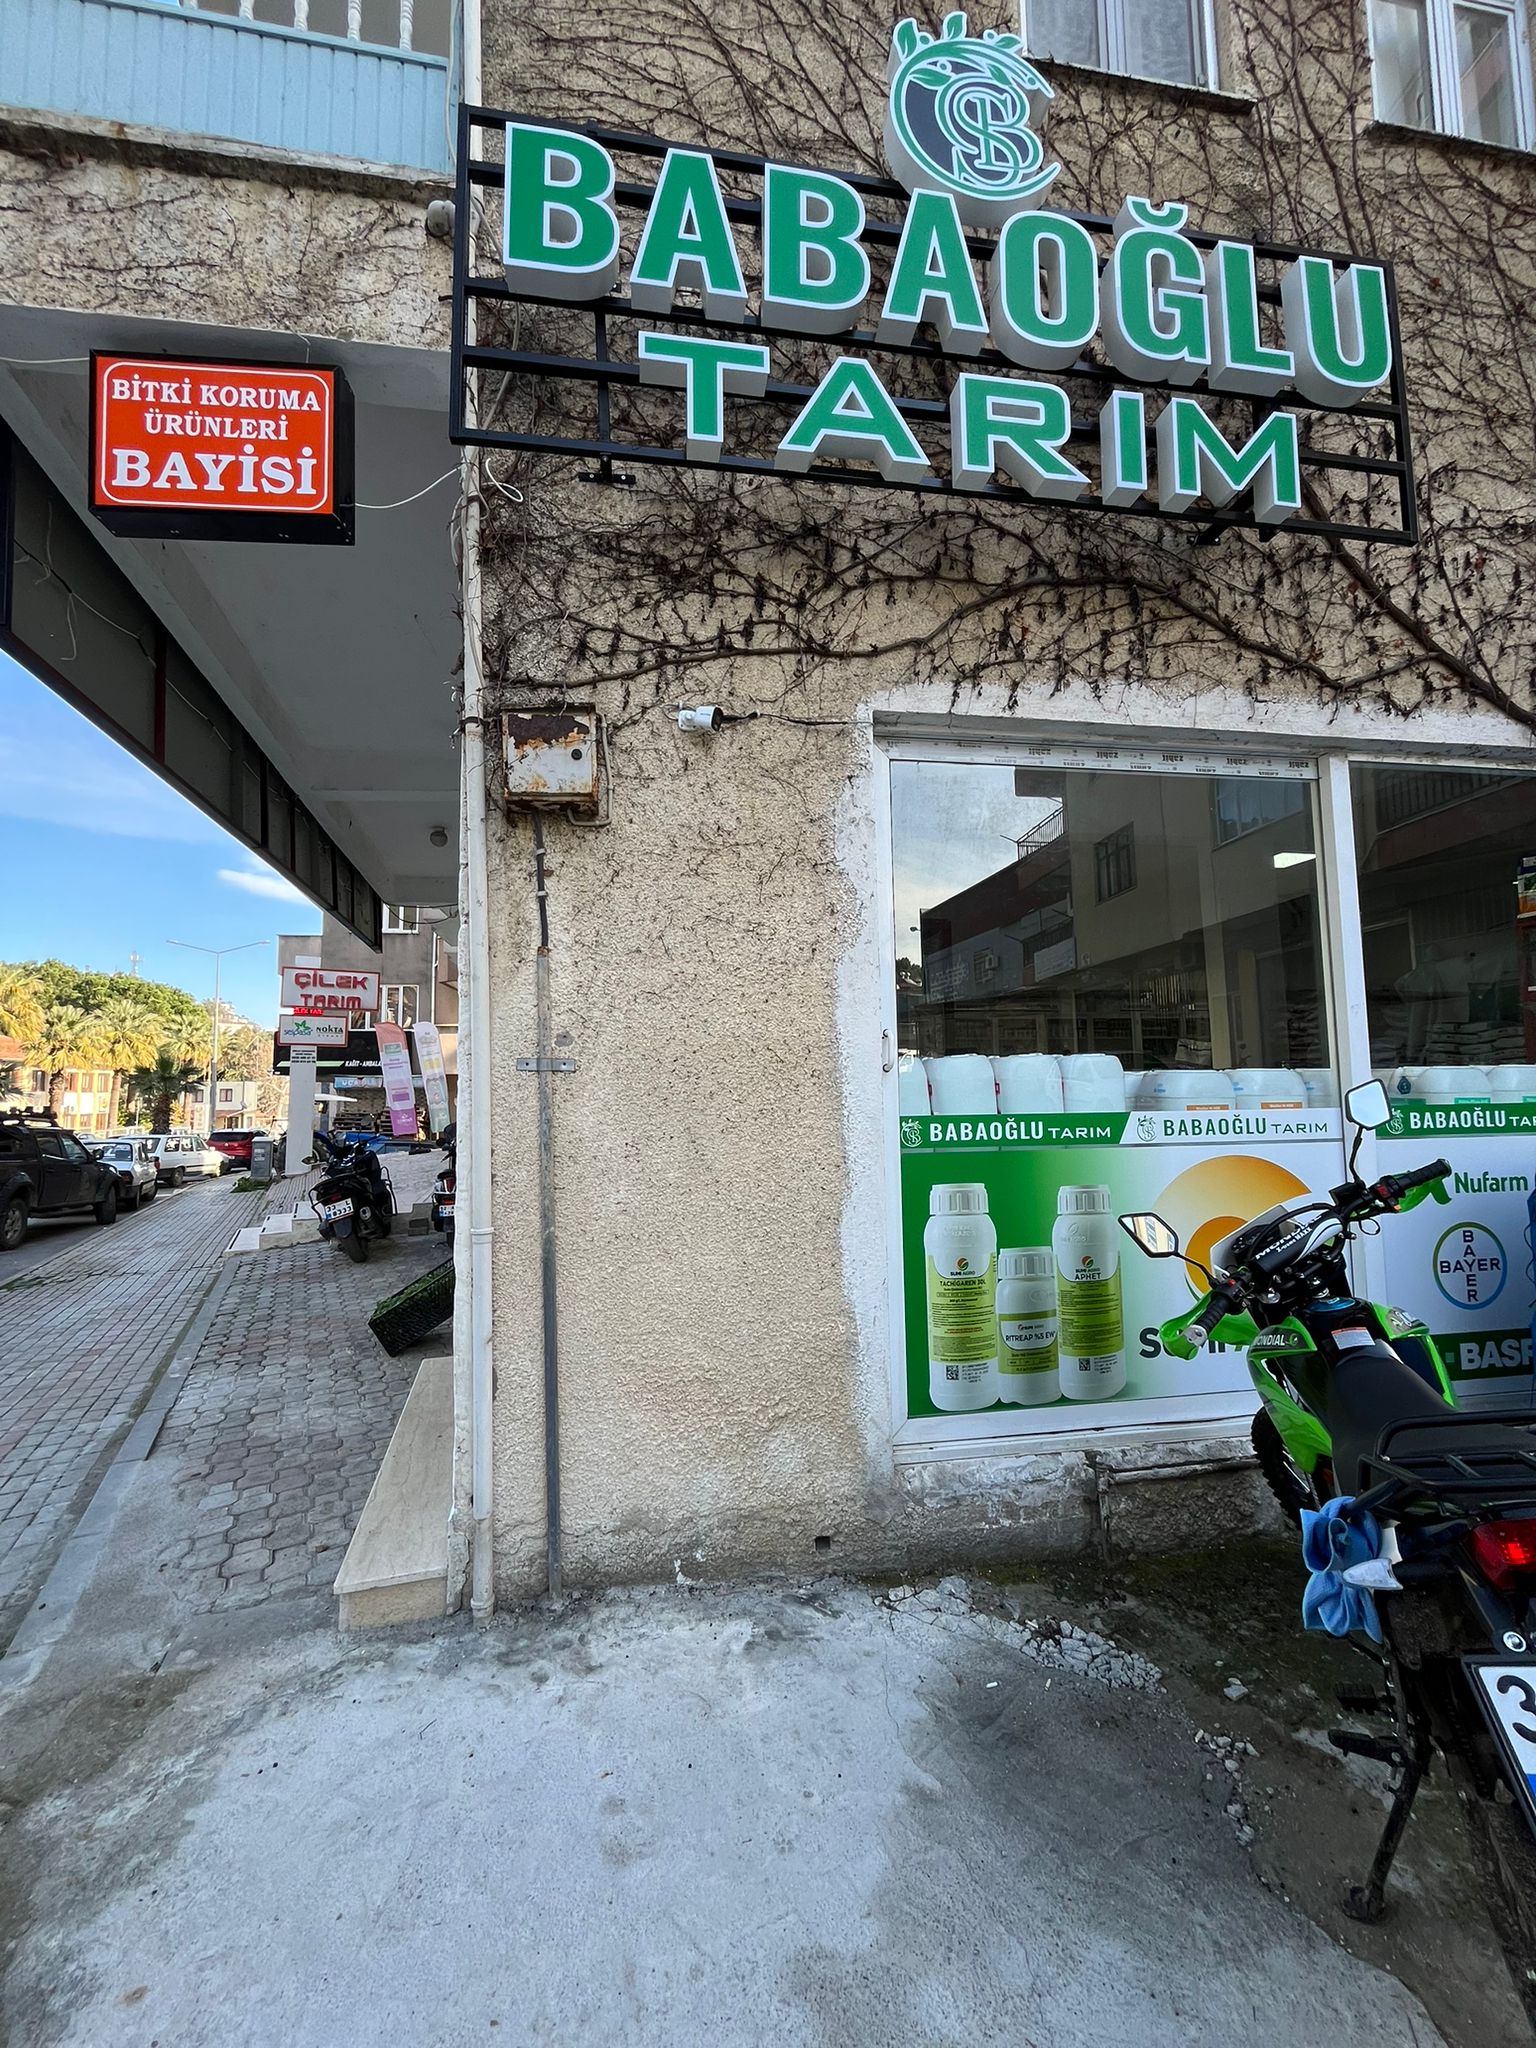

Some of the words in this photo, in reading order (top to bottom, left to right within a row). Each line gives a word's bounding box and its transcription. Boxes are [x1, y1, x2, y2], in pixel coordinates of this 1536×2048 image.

[503, 121, 1392, 387] BABAOĞLU
[112, 374, 192, 404] BİTKİ
[200, 384, 321, 411] KORUMA
[144, 408, 288, 440] ÜRÜNLERİ
[637, 331, 1301, 508] TARIM
[111, 444, 317, 495] BAYİSİ
[294, 969, 368, 990] ÇİLEK
[300, 994, 362, 1009] TARIM
[316, 1024, 343, 1034] NOKTA
[929, 1117, 1044, 1142] BABAOĞLU
[1048, 1126, 1111, 1139] TARIM
[1163, 1114, 1267, 1137] BABAOĞLU
[1271, 1122, 1328, 1134] TARIM
[1409, 1107, 1506, 1129] BABAOĞLU
[1454, 1172, 1529, 1194] Nufarm
[1075, 1272, 1102, 1280] APHET
[1440, 1258, 1501, 1273] BAYER
[1462, 1230, 1478, 1302] BAYER
